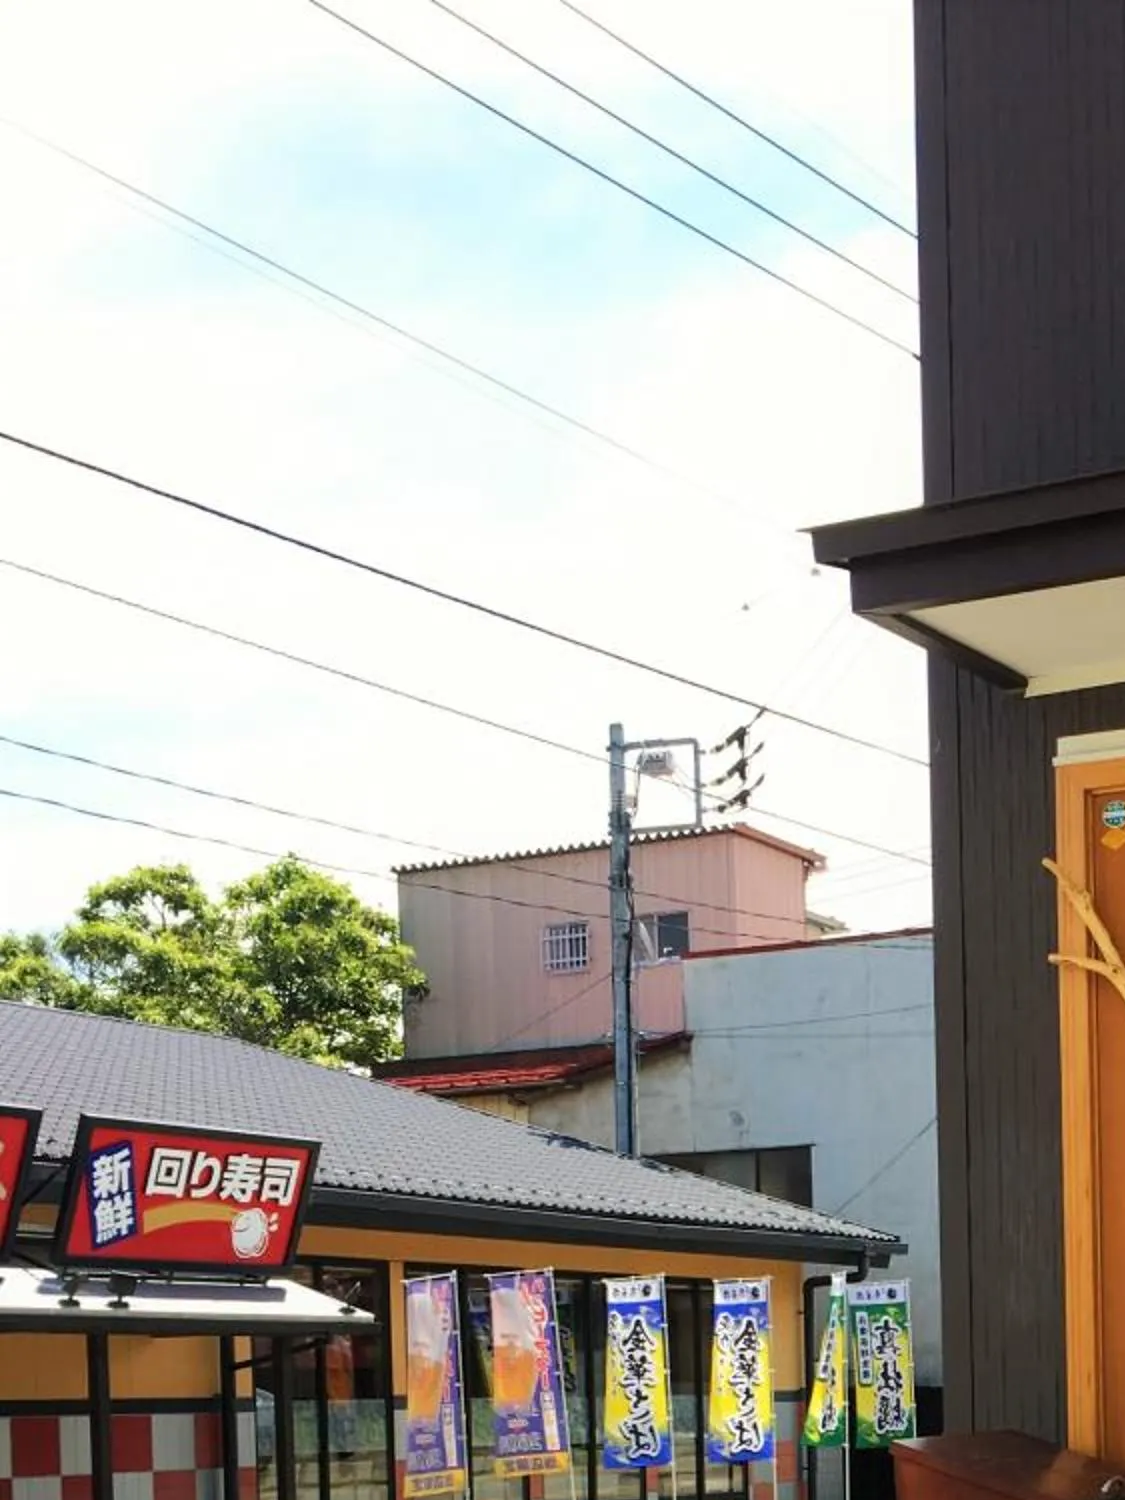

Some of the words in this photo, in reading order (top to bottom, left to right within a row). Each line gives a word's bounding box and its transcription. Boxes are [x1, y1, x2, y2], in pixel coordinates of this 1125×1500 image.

[91, 1147, 135, 1246] 新鮮
[145, 1146, 301, 1206] 回り寿司
